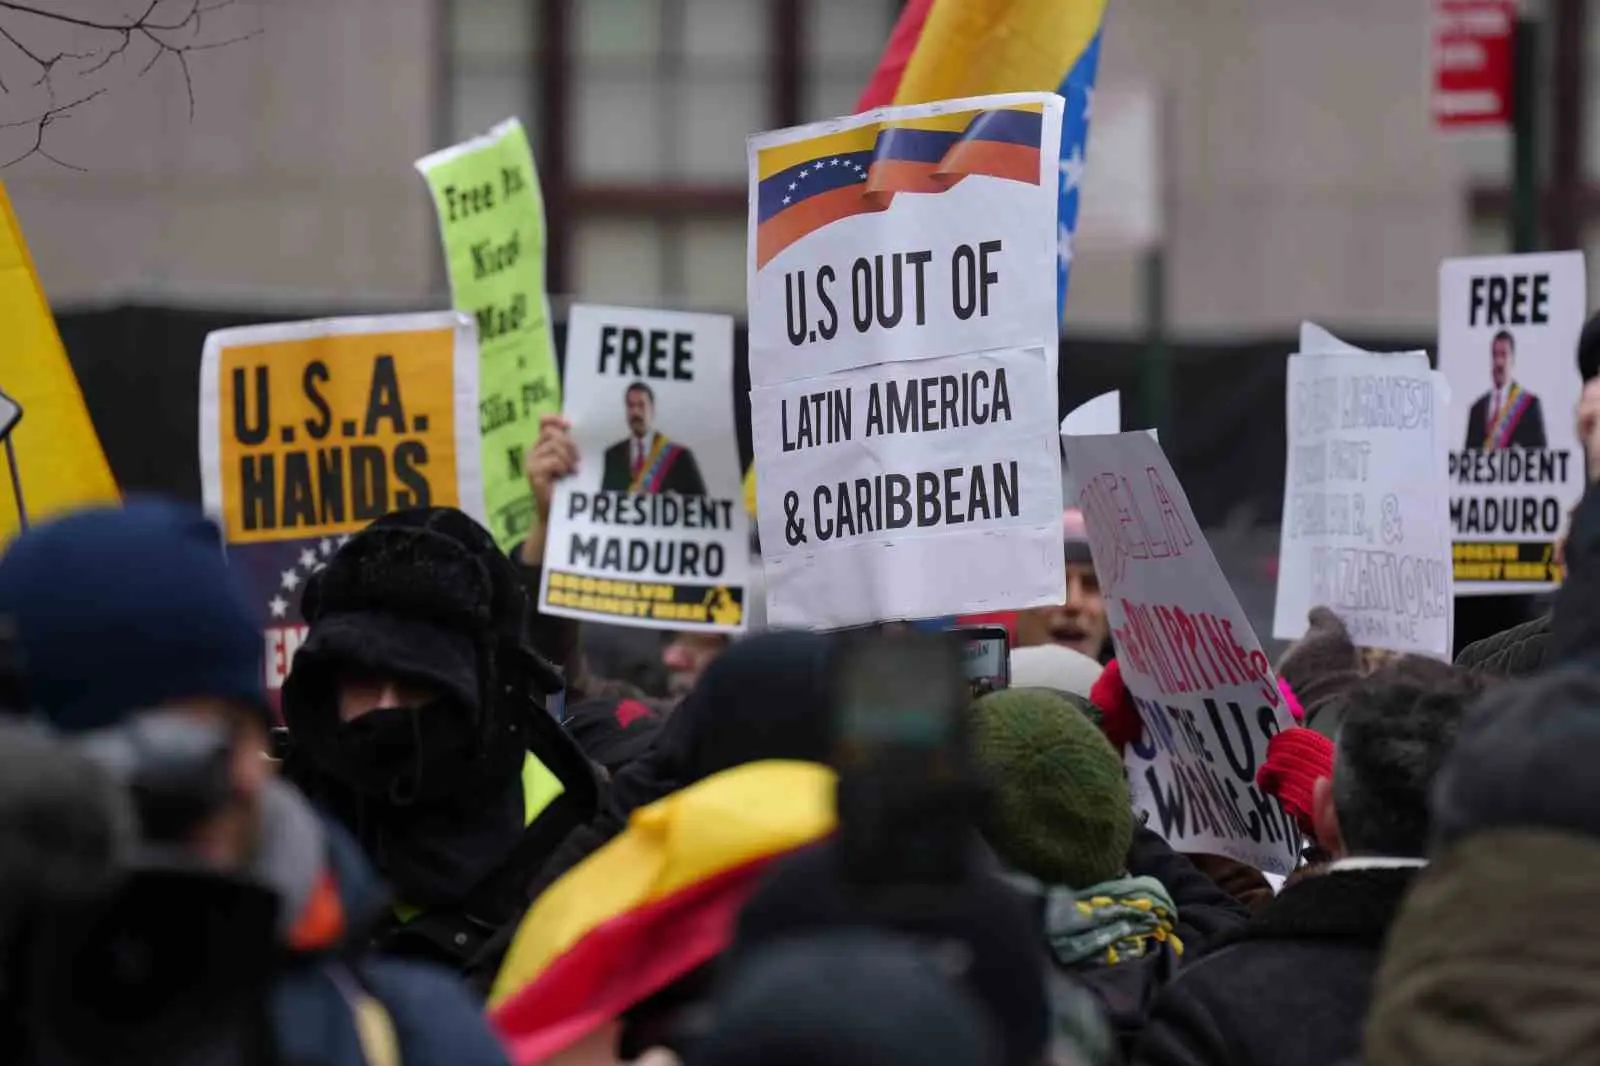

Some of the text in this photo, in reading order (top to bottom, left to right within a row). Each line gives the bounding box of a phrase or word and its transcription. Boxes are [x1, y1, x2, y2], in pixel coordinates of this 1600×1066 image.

[785, 240, 1003, 346] U.S OUT OF
[1469, 275, 1549, 327] FREE
[597, 326, 693, 381] FREE
[233, 355, 429, 444] U.S.A.
[782, 367, 1012, 452] LATIN AMERICA
[240, 440, 431, 530] HANDS
[568, 492, 735, 530] PRESIDENT
[783, 461, 1020, 546] & CARIBBEAN
[1450, 497, 1559, 533] MADURO
[569, 532, 725, 576] MADURO
